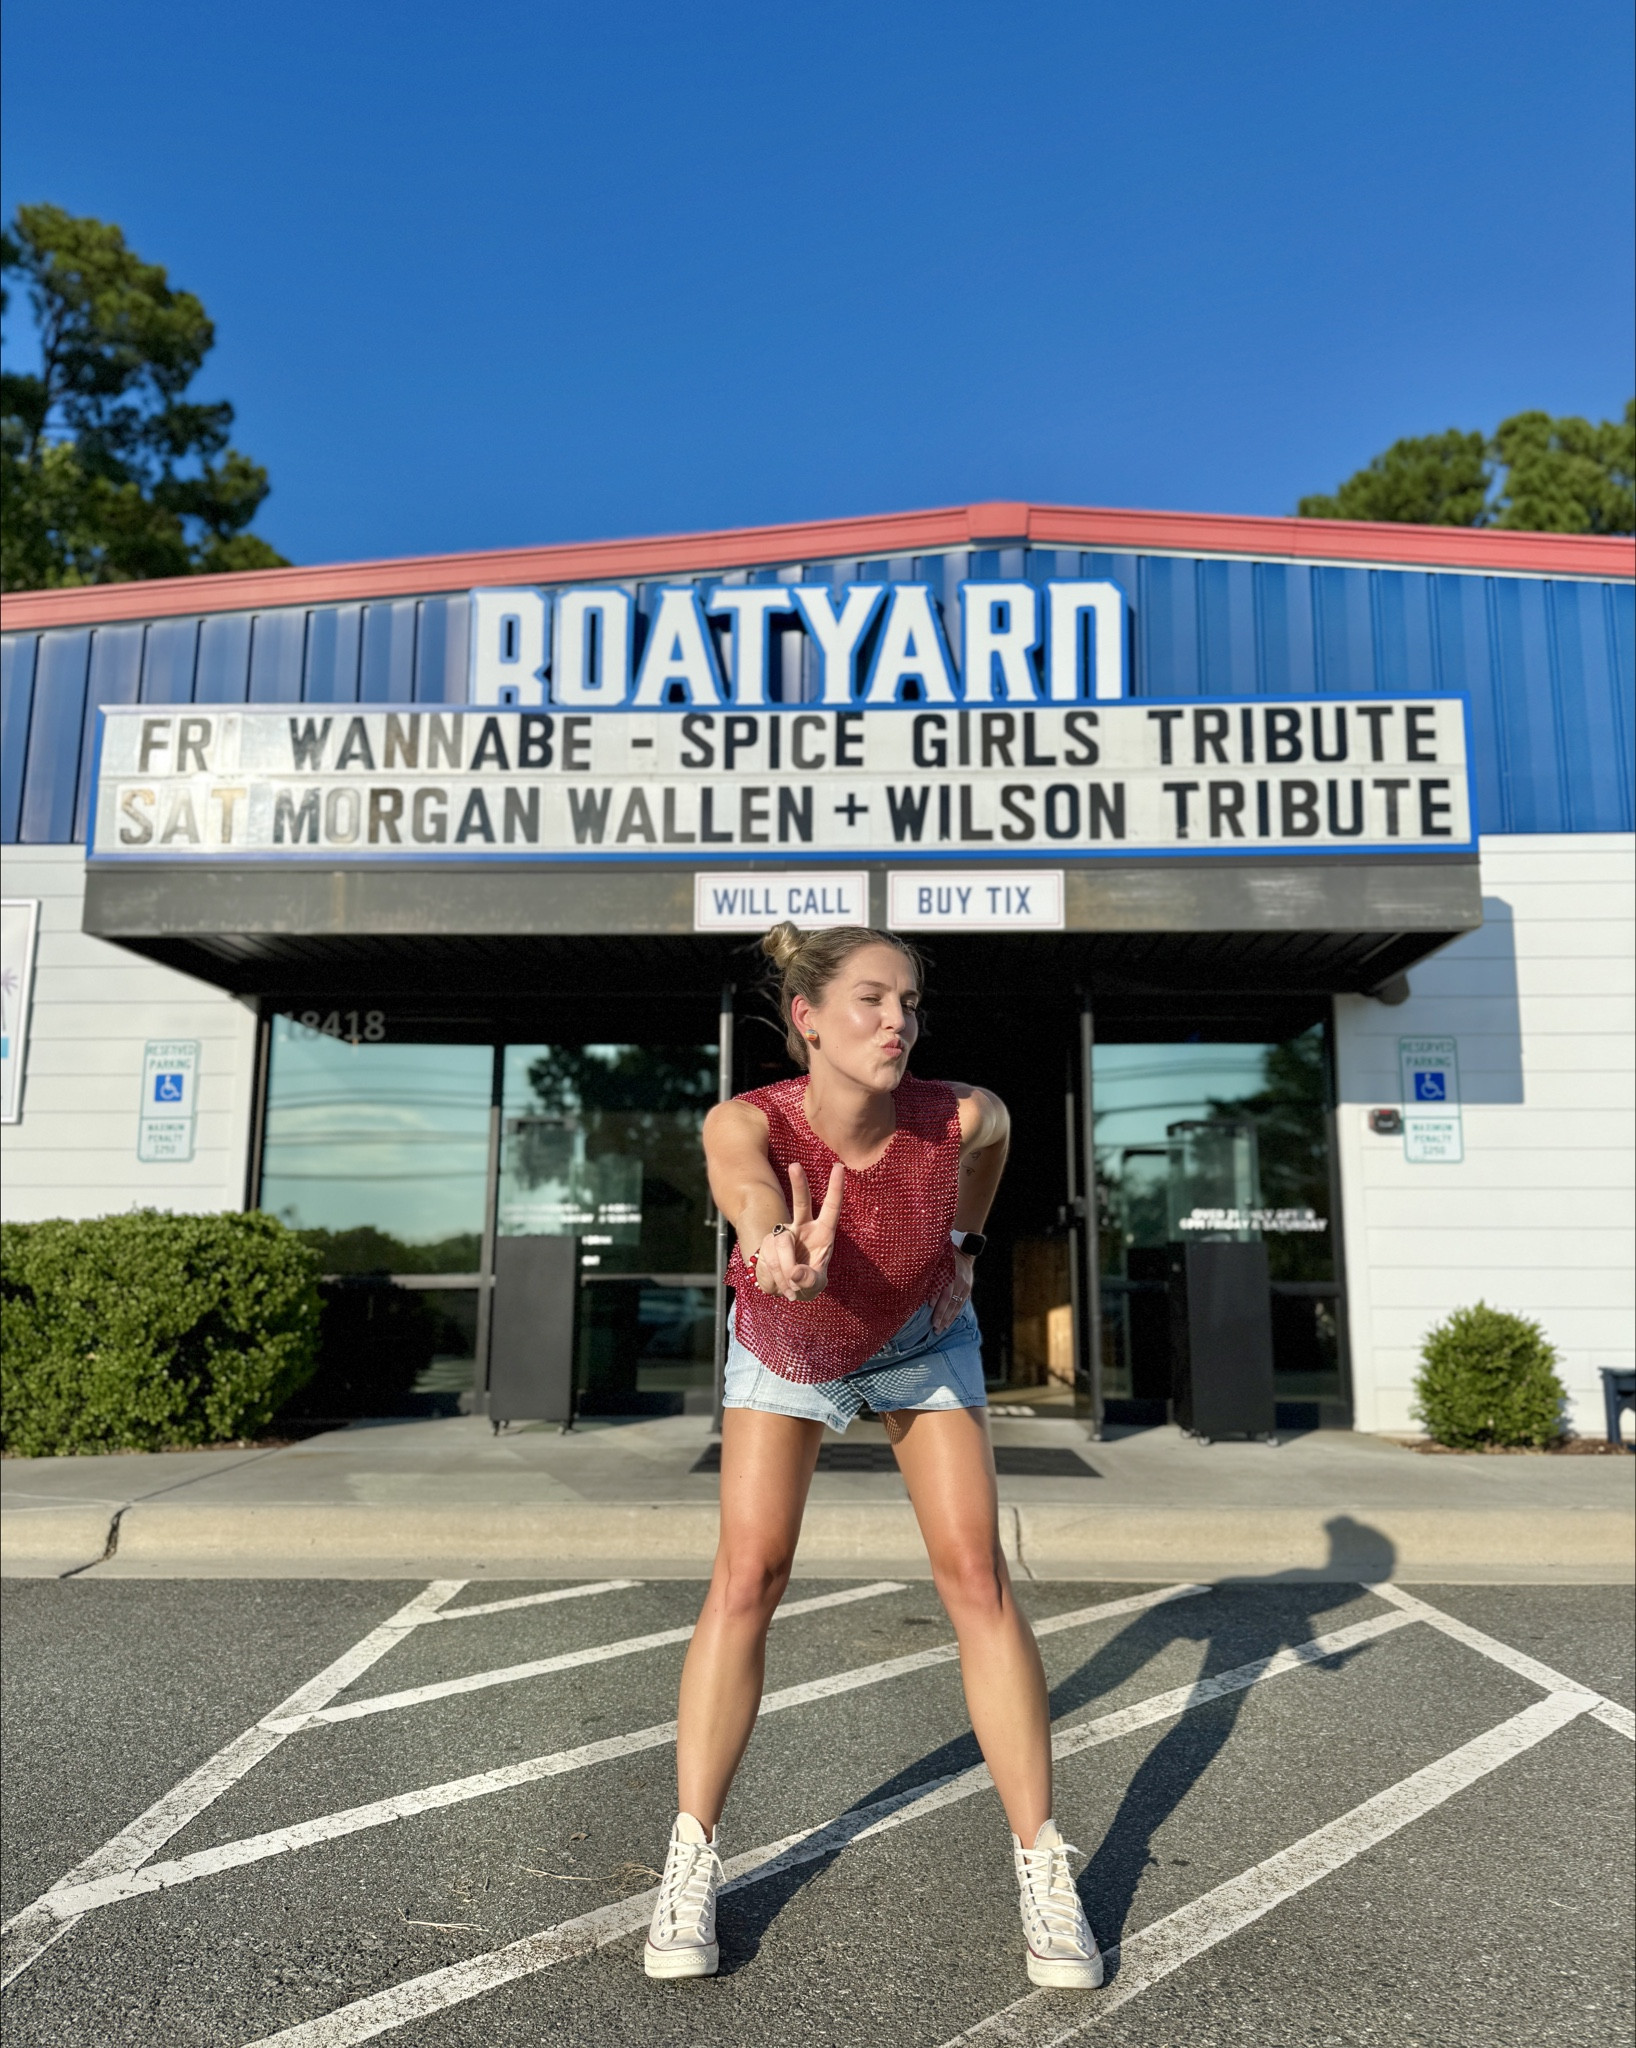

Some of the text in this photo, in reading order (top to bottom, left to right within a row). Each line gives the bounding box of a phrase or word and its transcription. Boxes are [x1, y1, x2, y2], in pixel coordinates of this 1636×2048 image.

[138, 706, 1438, 772] FR WANNABE - SPICE GIRLS TRIBUTE
[119, 778, 1453, 845] SAT MORGAN WALLEN + WILSON TRIBUTE
[712, 887, 851, 915] WILL CALL
[917, 885, 1032, 915] BUY TIX
[149, 1060, 191, 1070] PARKING
[1406, 1057, 1452, 1067] PARKING
